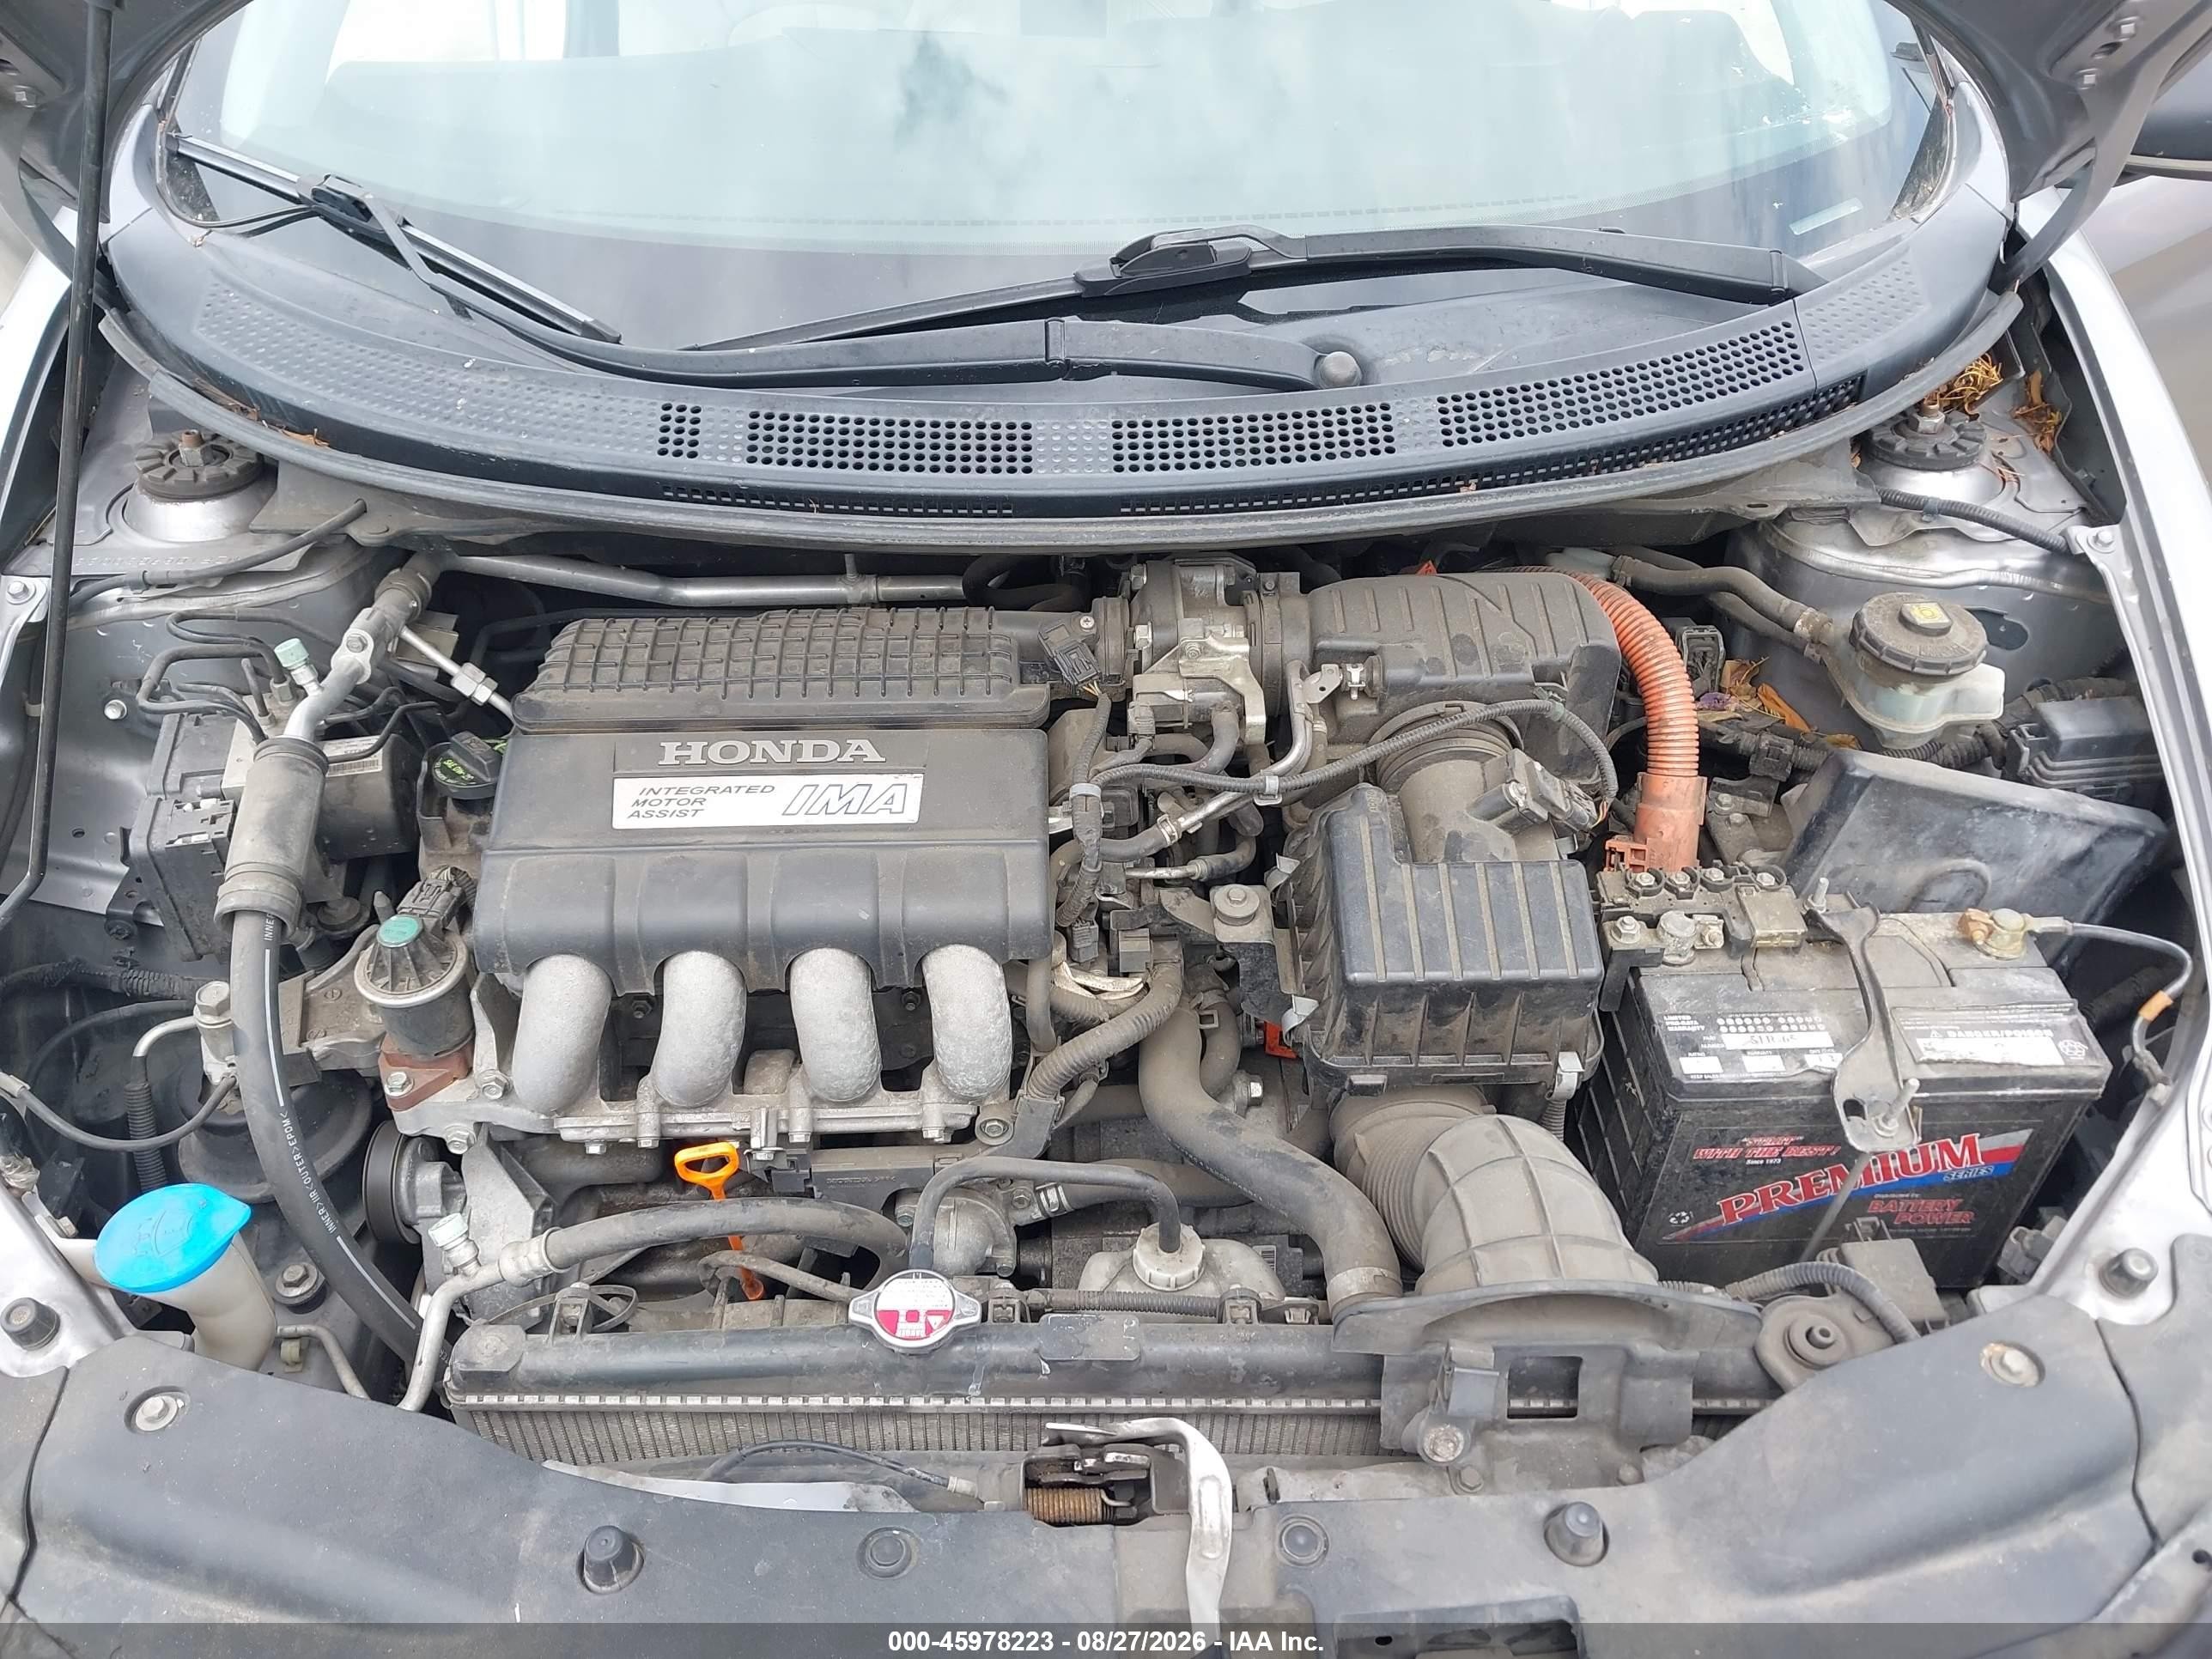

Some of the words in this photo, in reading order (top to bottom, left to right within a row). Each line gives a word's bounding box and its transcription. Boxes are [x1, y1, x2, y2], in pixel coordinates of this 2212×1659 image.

[657, 738, 886, 765] HONDA
[631, 798, 707, 807] MOTOR
[639, 785, 775, 796] INTEGRATED
[781, 783, 908, 816] IMA
[627, 809, 705, 818] ASSIST
[1947, 1030, 2054, 1038] DANGER/POISON
[1692, 1146, 1744, 1160] WITH
[1744, 1146, 1784, 1158] THE
[1782, 1145, 1842, 1158] BEST!
[1717, 1133, 1984, 1225] PREMIUM
[1942, 1165, 1995, 1182] SERIES
[1867, 1198, 1965, 1213] BATTERY
[1893, 1211, 1976, 1224] POWER
